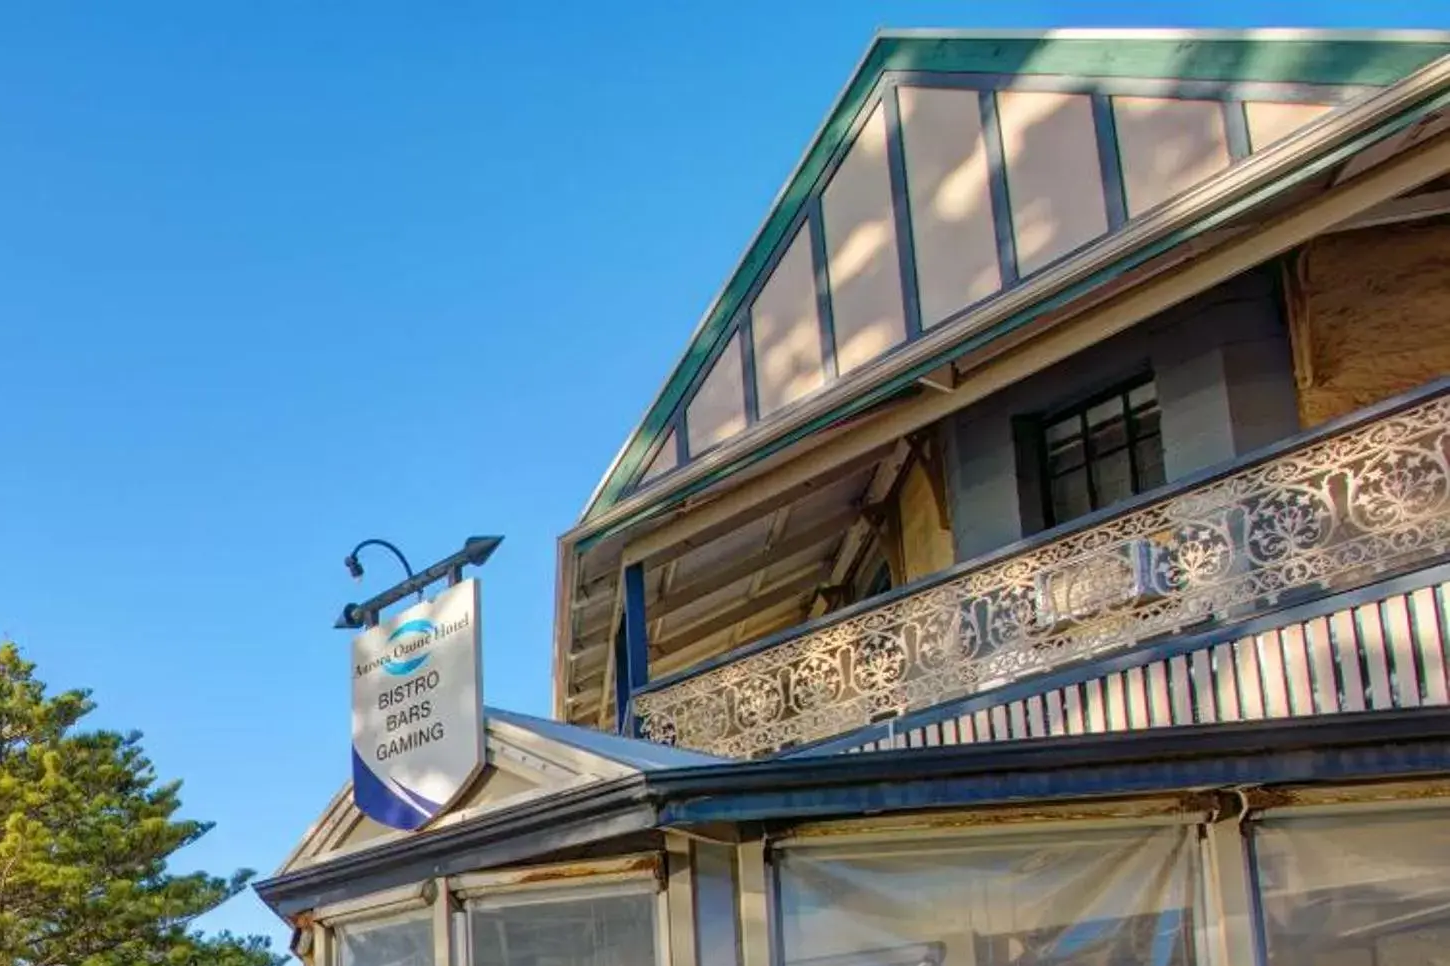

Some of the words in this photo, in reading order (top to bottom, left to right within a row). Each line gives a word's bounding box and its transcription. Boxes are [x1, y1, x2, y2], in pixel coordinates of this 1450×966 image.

[433, 611, 469, 640] Hotel
[378, 670, 440, 710] BISTRO
[386, 700, 432, 732] BARS
[376, 721, 444, 761] GAMING
